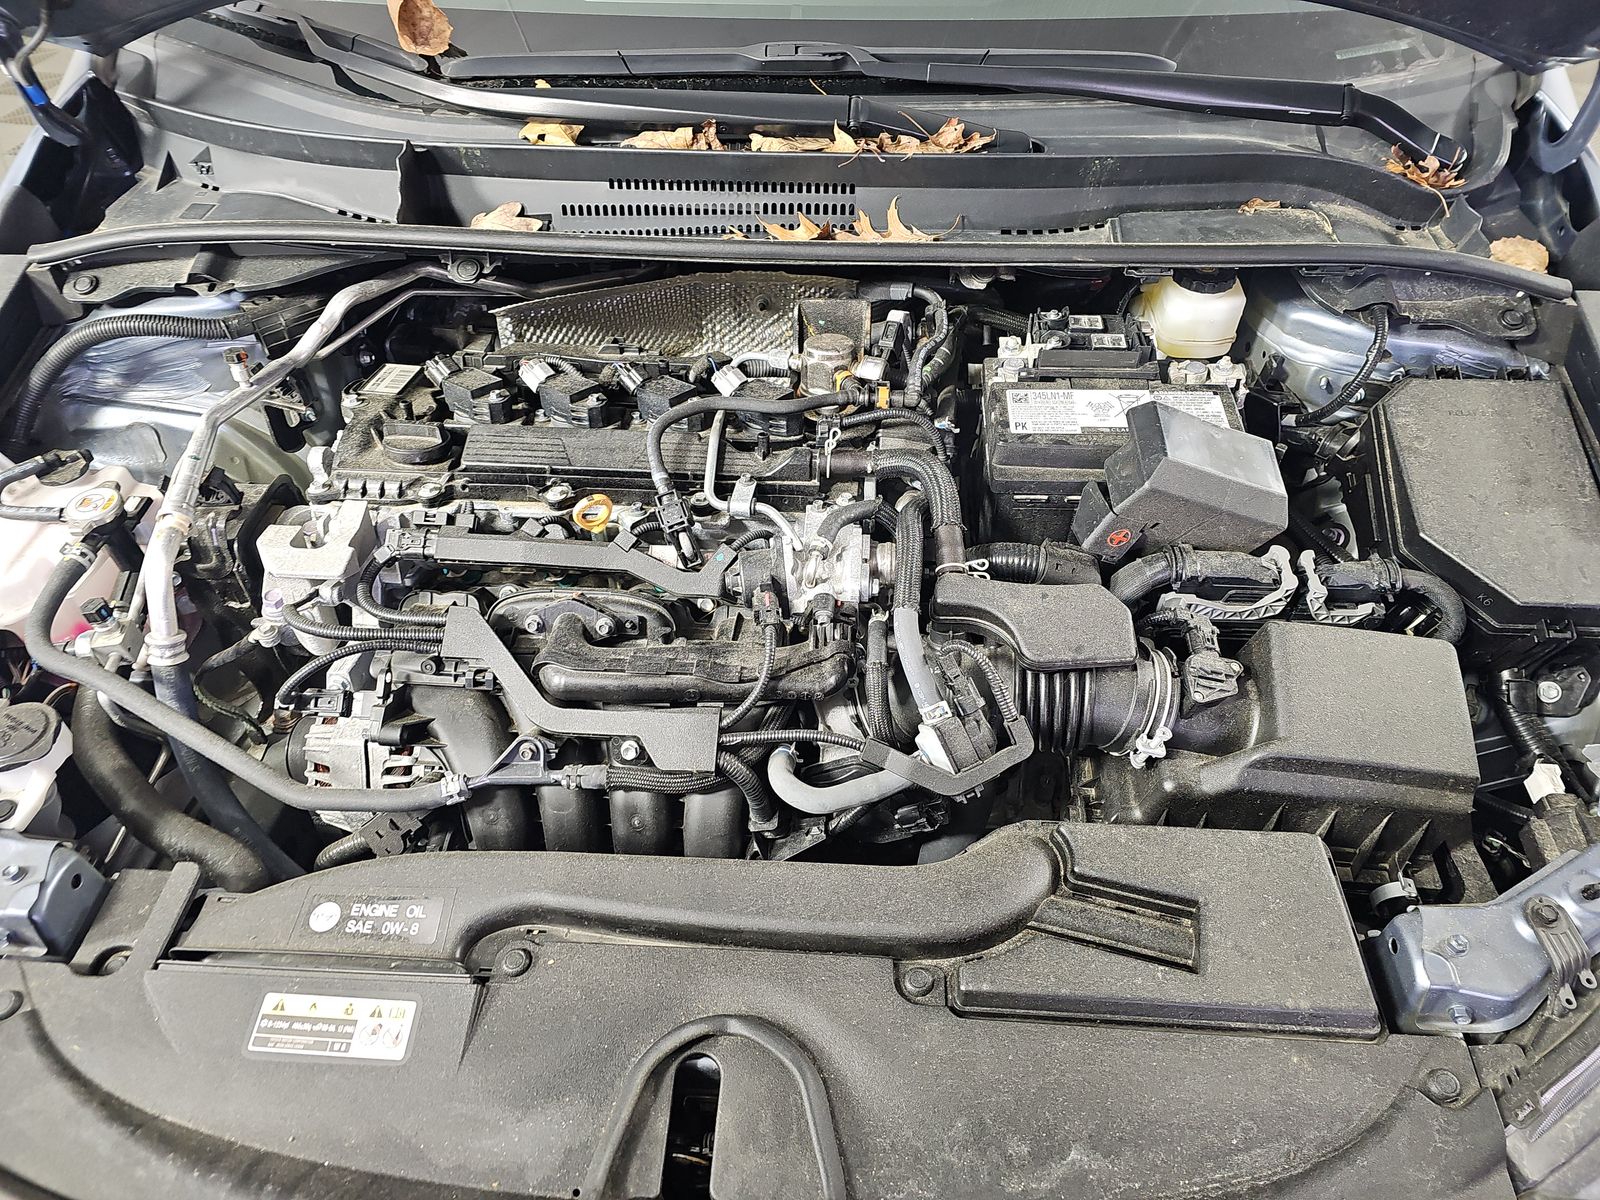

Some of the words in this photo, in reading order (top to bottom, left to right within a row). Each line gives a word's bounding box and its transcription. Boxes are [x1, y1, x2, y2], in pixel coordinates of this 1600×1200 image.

[1032, 391, 1075, 400] 345LN1-MF
[1014, 421, 1028, 431] PK
[350, 903, 400, 918] ENGINE
[405, 904, 427, 919] OIL
[345, 920, 374, 934] SAE
